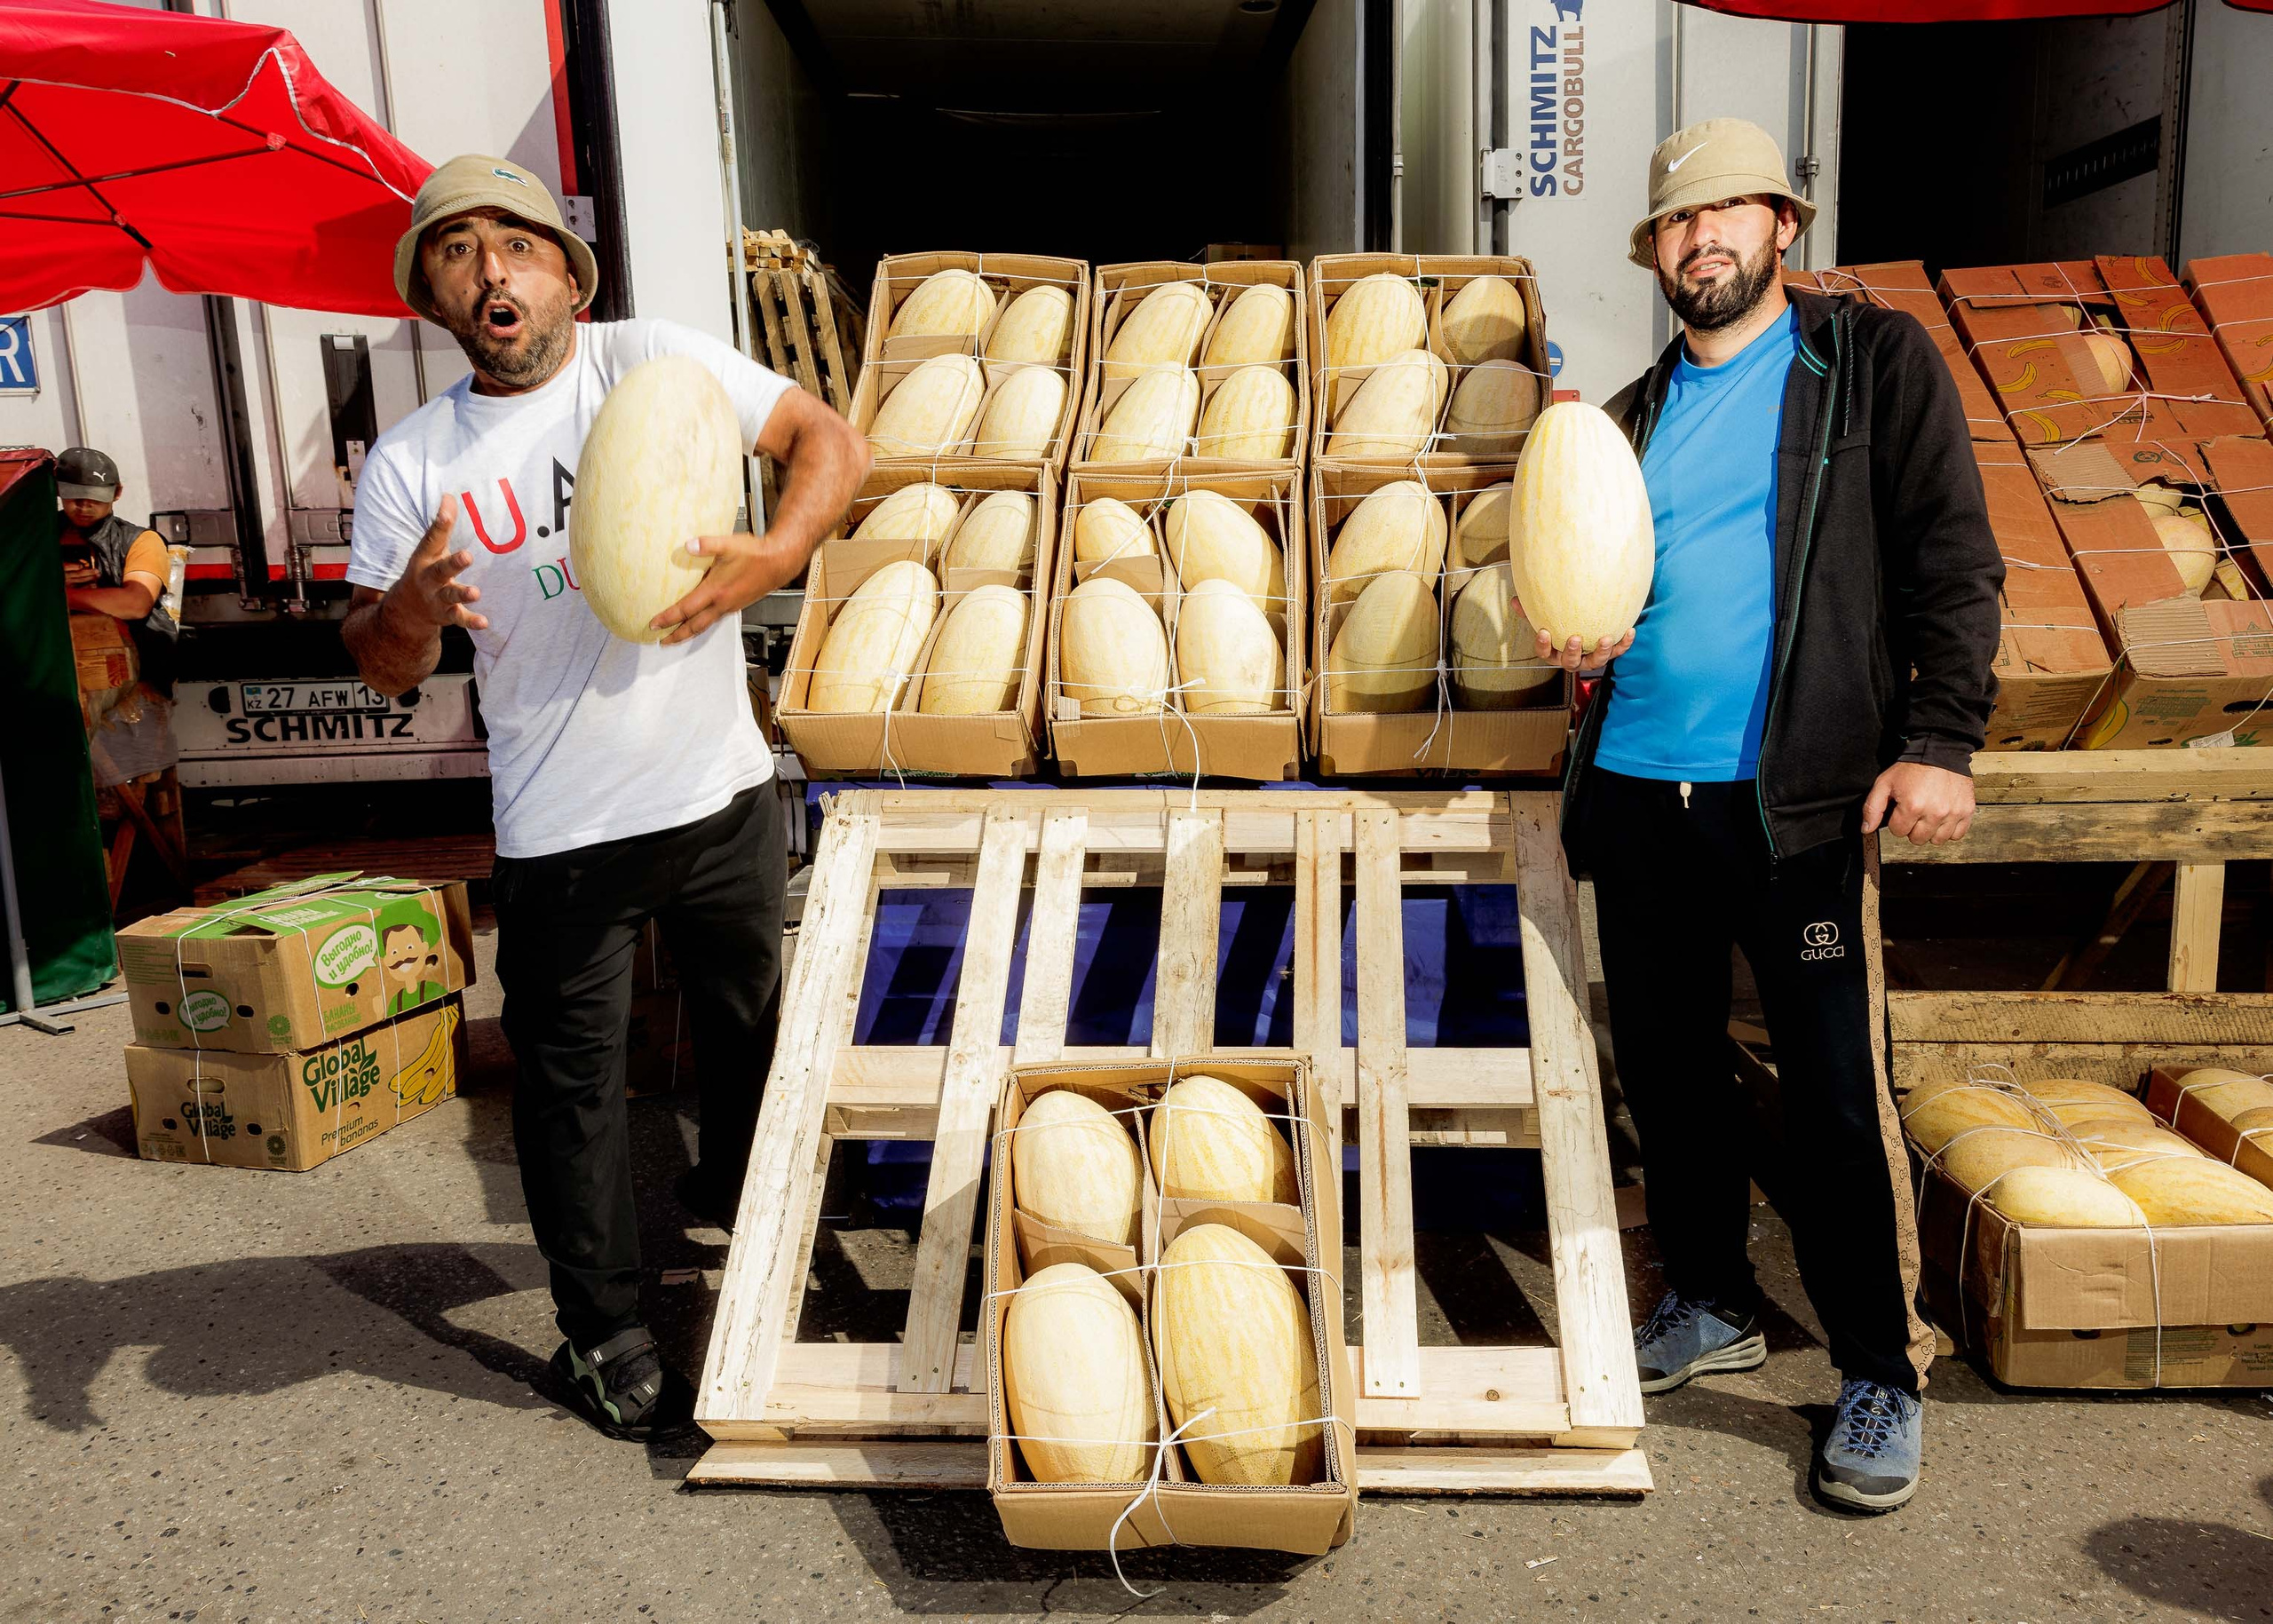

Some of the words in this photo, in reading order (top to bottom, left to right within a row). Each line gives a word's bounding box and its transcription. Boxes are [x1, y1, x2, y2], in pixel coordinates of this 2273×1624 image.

[1530, 26, 1556, 196] SCHMITZ
[1564, 26, 1584, 196] CARGOBULL
[247, 700, 263, 709] KZ
[266, 686, 295, 709] 27
[308, 690, 348, 708] AFW
[226, 713, 415, 744] SCHMITZ
[321, 930, 362, 968] Выгодно
[329, 970, 338, 980] и
[337, 939, 373, 975] удобно!
[1801, 945, 1844, 961] GUCCI
[321, 1116, 363, 1146] Premium
[340, 1119, 379, 1147] bananas
